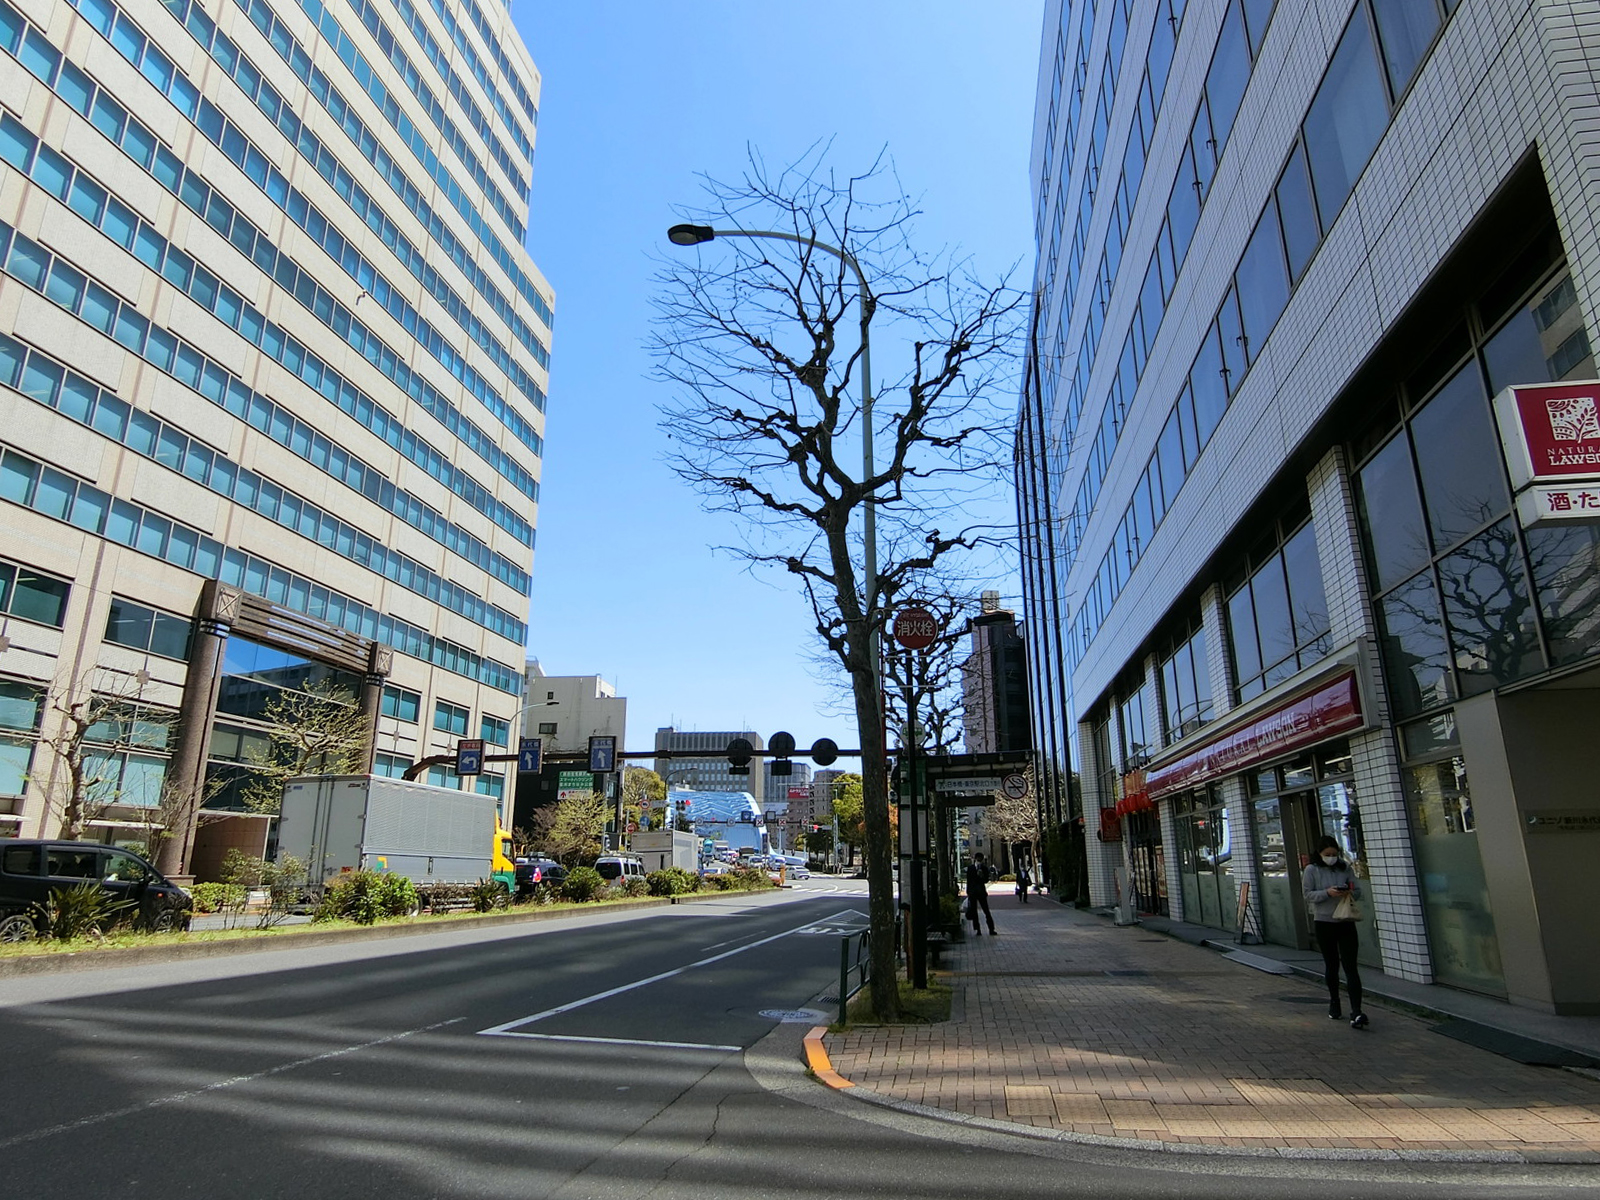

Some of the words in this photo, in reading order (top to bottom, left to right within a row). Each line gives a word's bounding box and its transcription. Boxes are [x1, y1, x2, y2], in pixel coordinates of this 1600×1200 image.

[1547, 446, 1600, 455] NATUR
[1547, 492, 1600, 511] 酒・た
[897, 620, 934, 637] 消火栓
[1255, 711, 1297, 748] LAWSON
